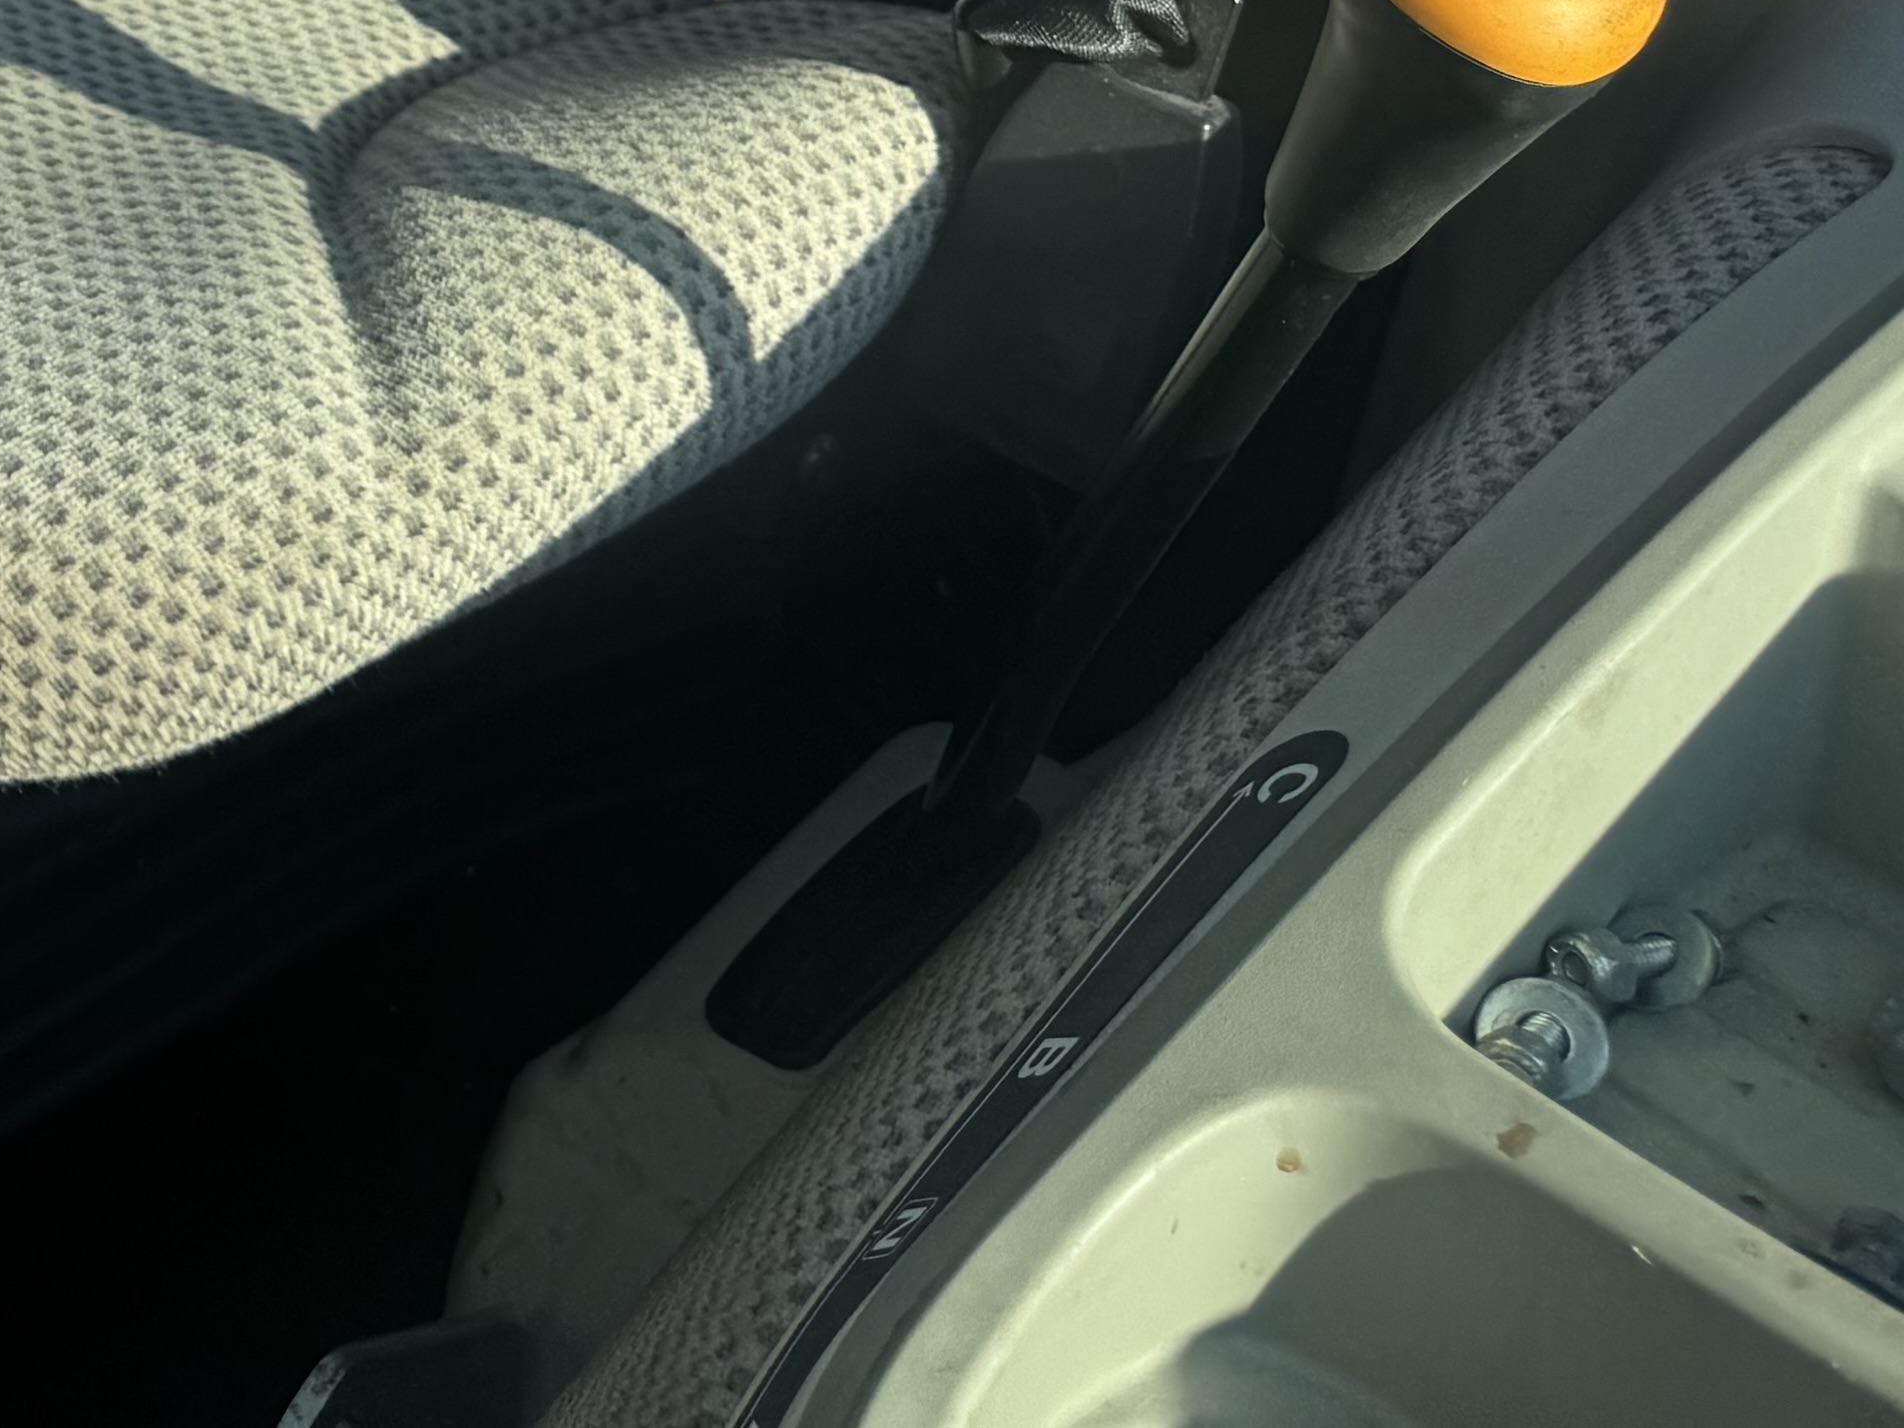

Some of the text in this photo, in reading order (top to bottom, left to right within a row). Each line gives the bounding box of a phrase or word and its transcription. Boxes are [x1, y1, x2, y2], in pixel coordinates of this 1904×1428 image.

[1257, 762, 1320, 807] C
[1018, 1036, 1079, 1079] B
[871, 1206, 929, 1251] N
